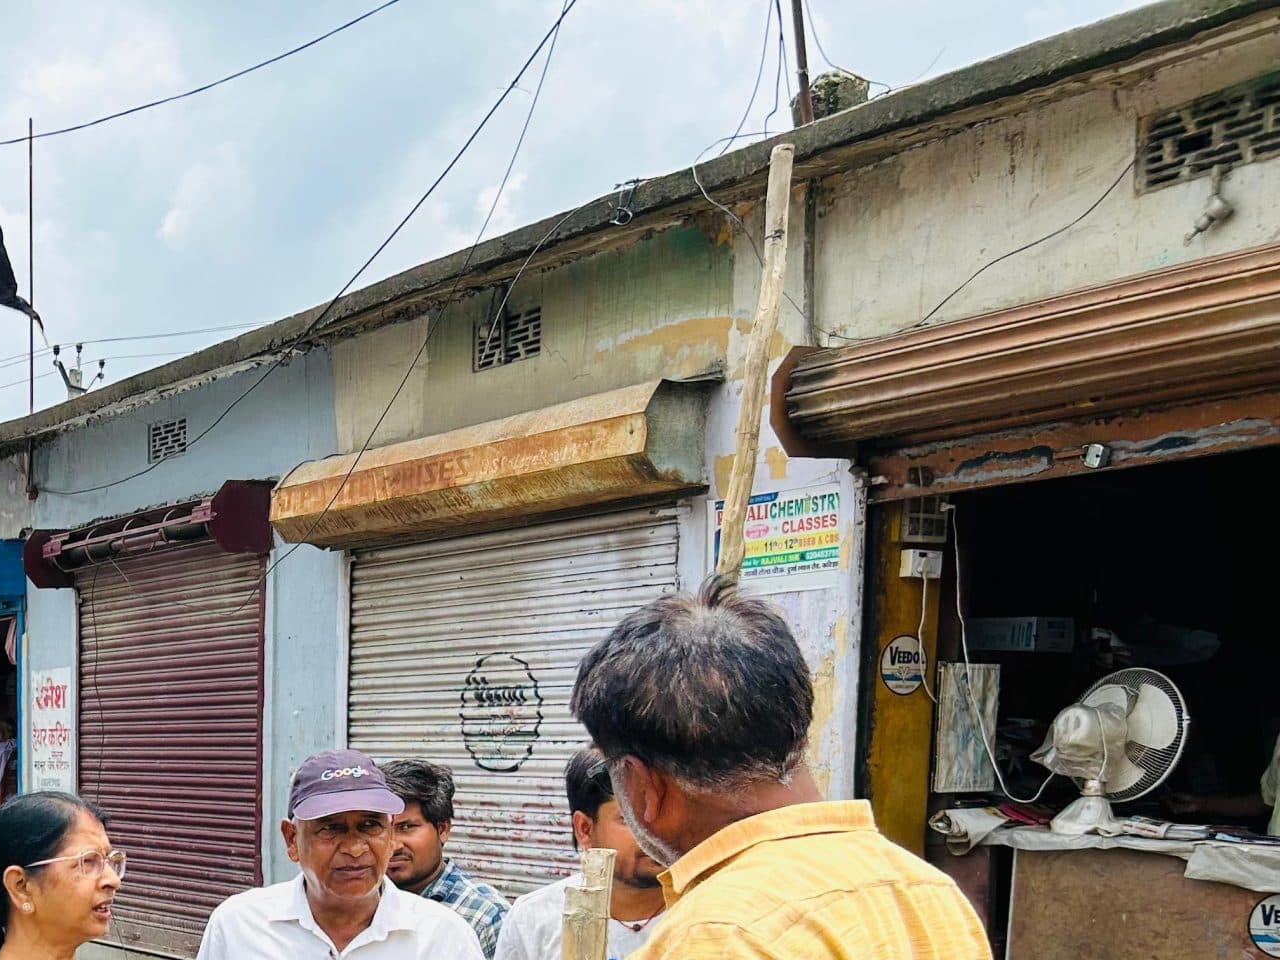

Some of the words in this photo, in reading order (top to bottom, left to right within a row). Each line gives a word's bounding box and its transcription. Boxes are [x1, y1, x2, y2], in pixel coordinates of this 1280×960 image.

[782, 513, 837, 534] CLASSES
[889, 646, 925, 666] VEEDO
[321, 765, 370, 780] Google
